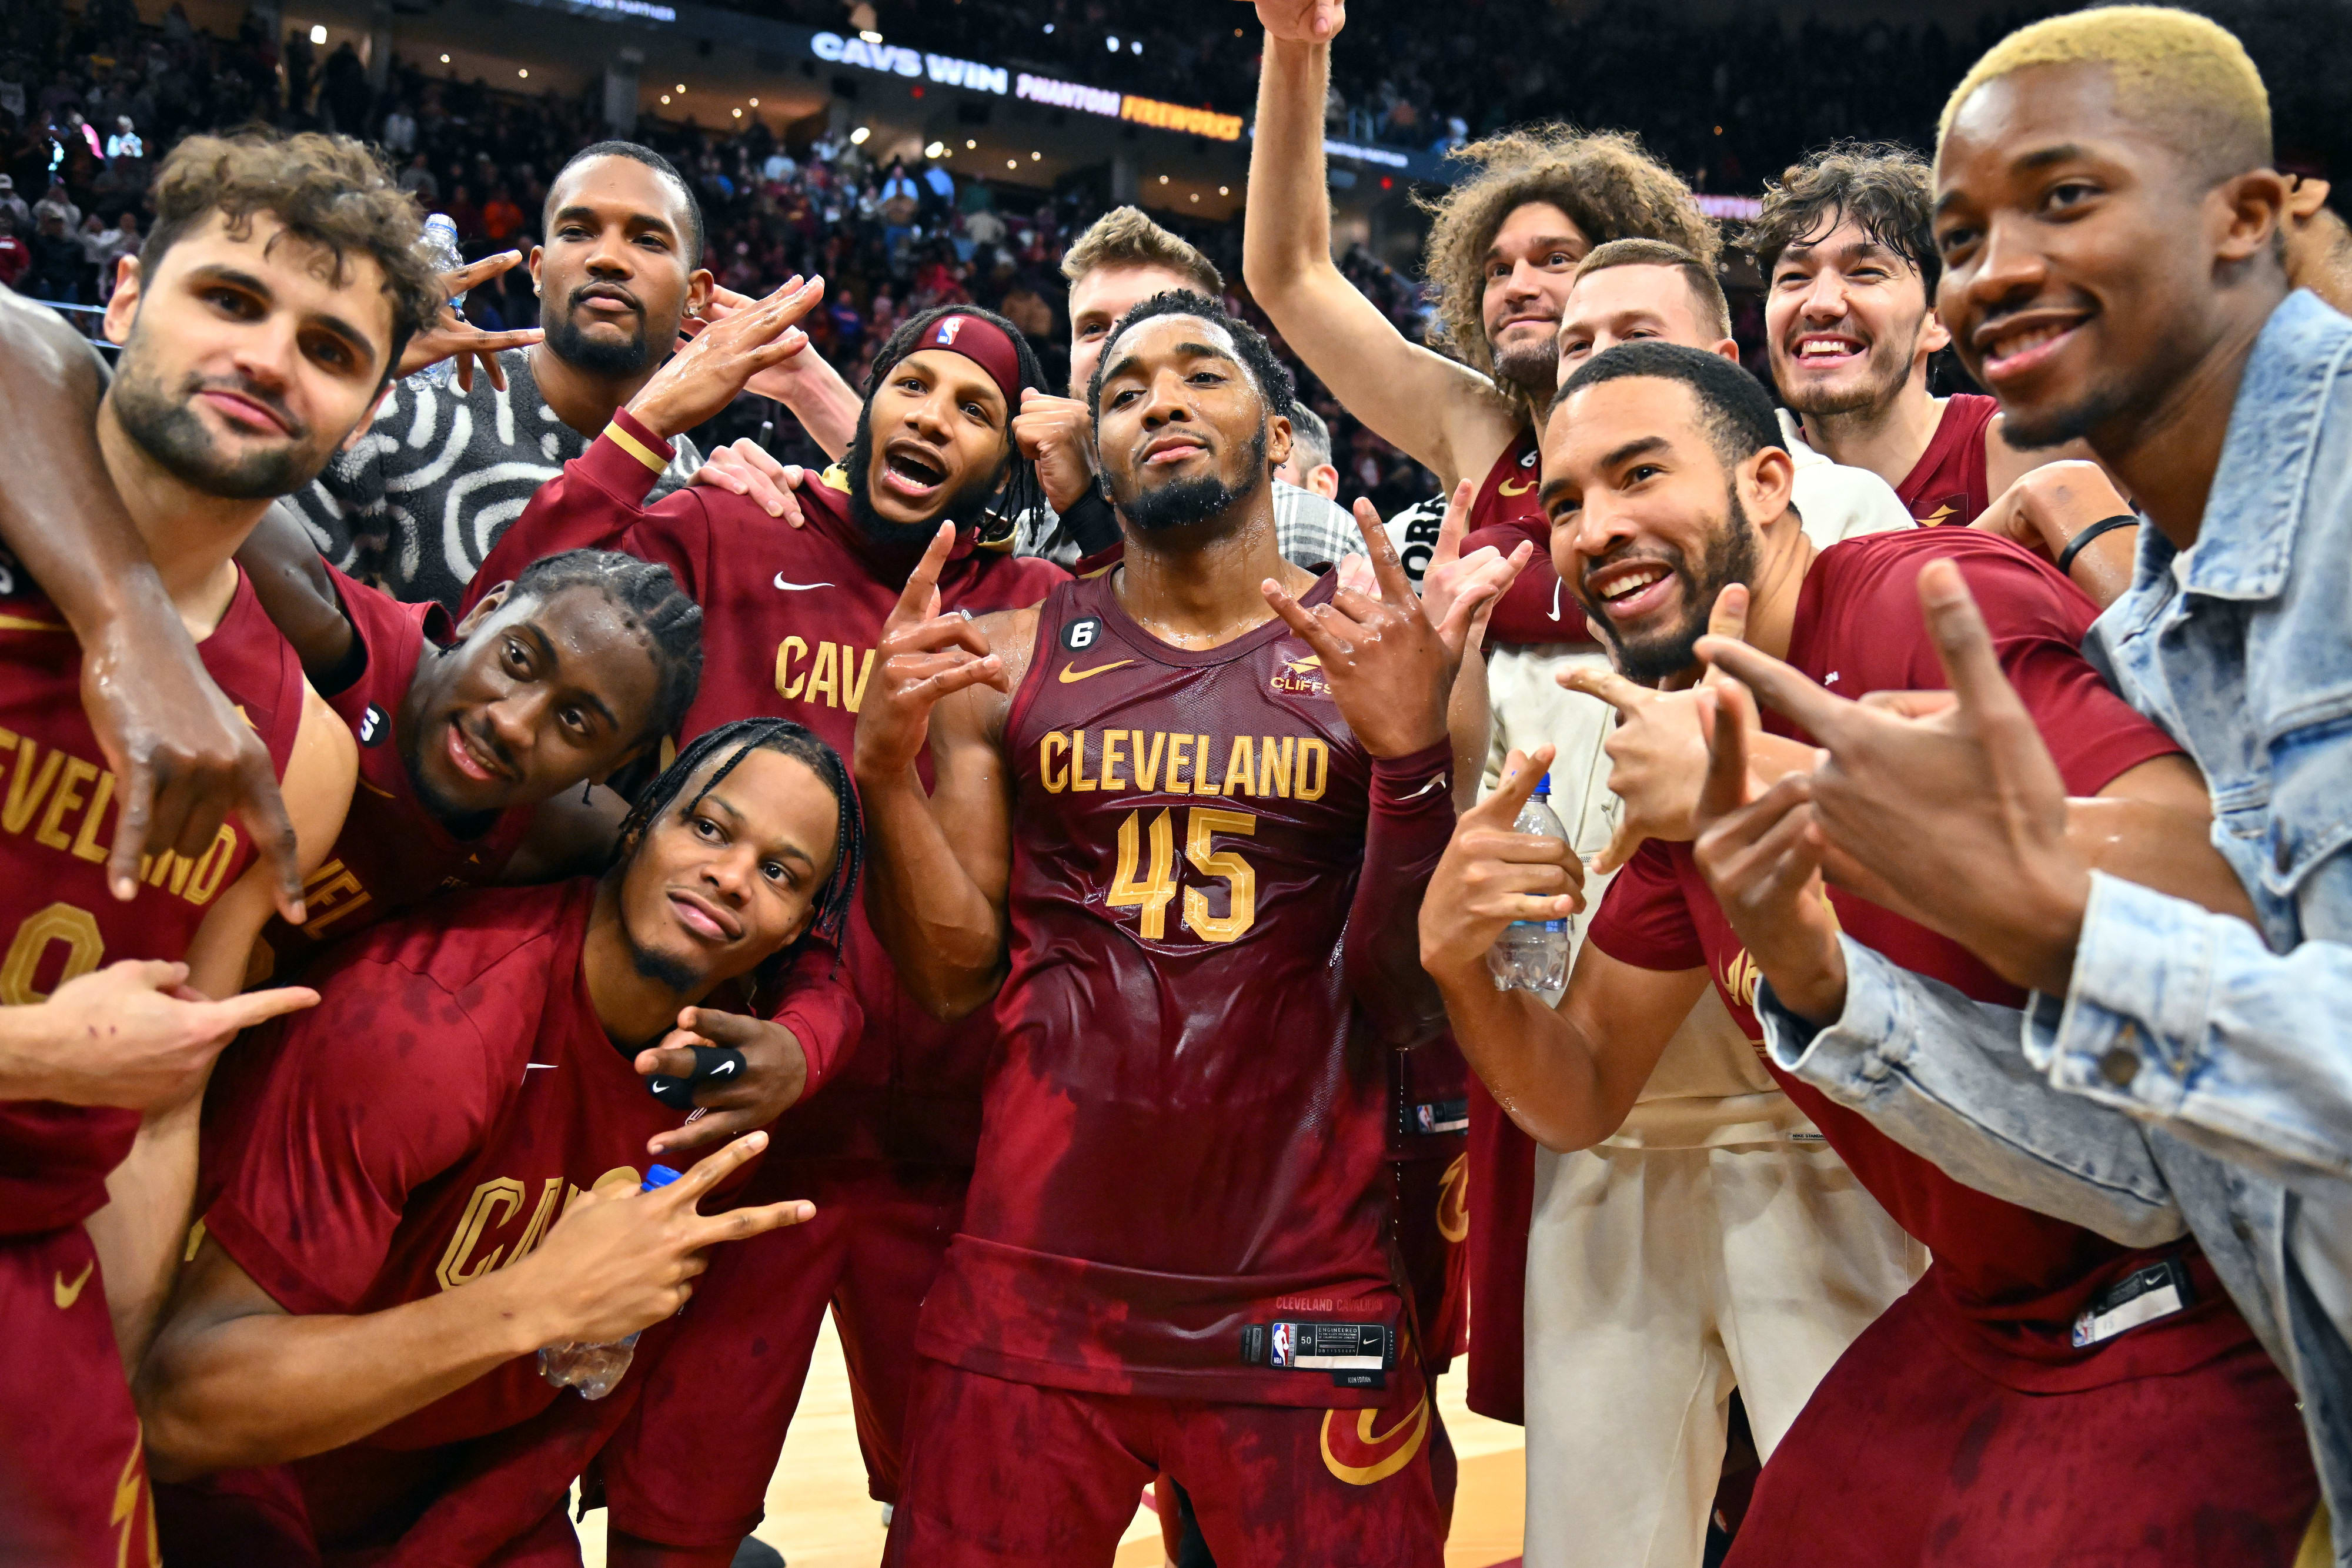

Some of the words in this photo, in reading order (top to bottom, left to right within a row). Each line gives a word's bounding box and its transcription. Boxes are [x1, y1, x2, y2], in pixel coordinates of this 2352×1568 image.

[811, 31, 923, 78] CAVS
[925, 54, 1008, 95] WIN
[1015, 72, 1121, 118] PHANTOM
[1120, 95, 1243, 142] FIREWORKS
[1070, 621, 1094, 648] 6
[774, 636, 877, 713] CAV
[1270, 677, 1332, 694] CLIFFS
[1040, 729, 1329, 801] CLEVELAND
[1105, 806, 1257, 942] 45
[1275, 1296, 1333, 1312] CLEVELAND
[1301, 1336, 1312, 1345] 50
